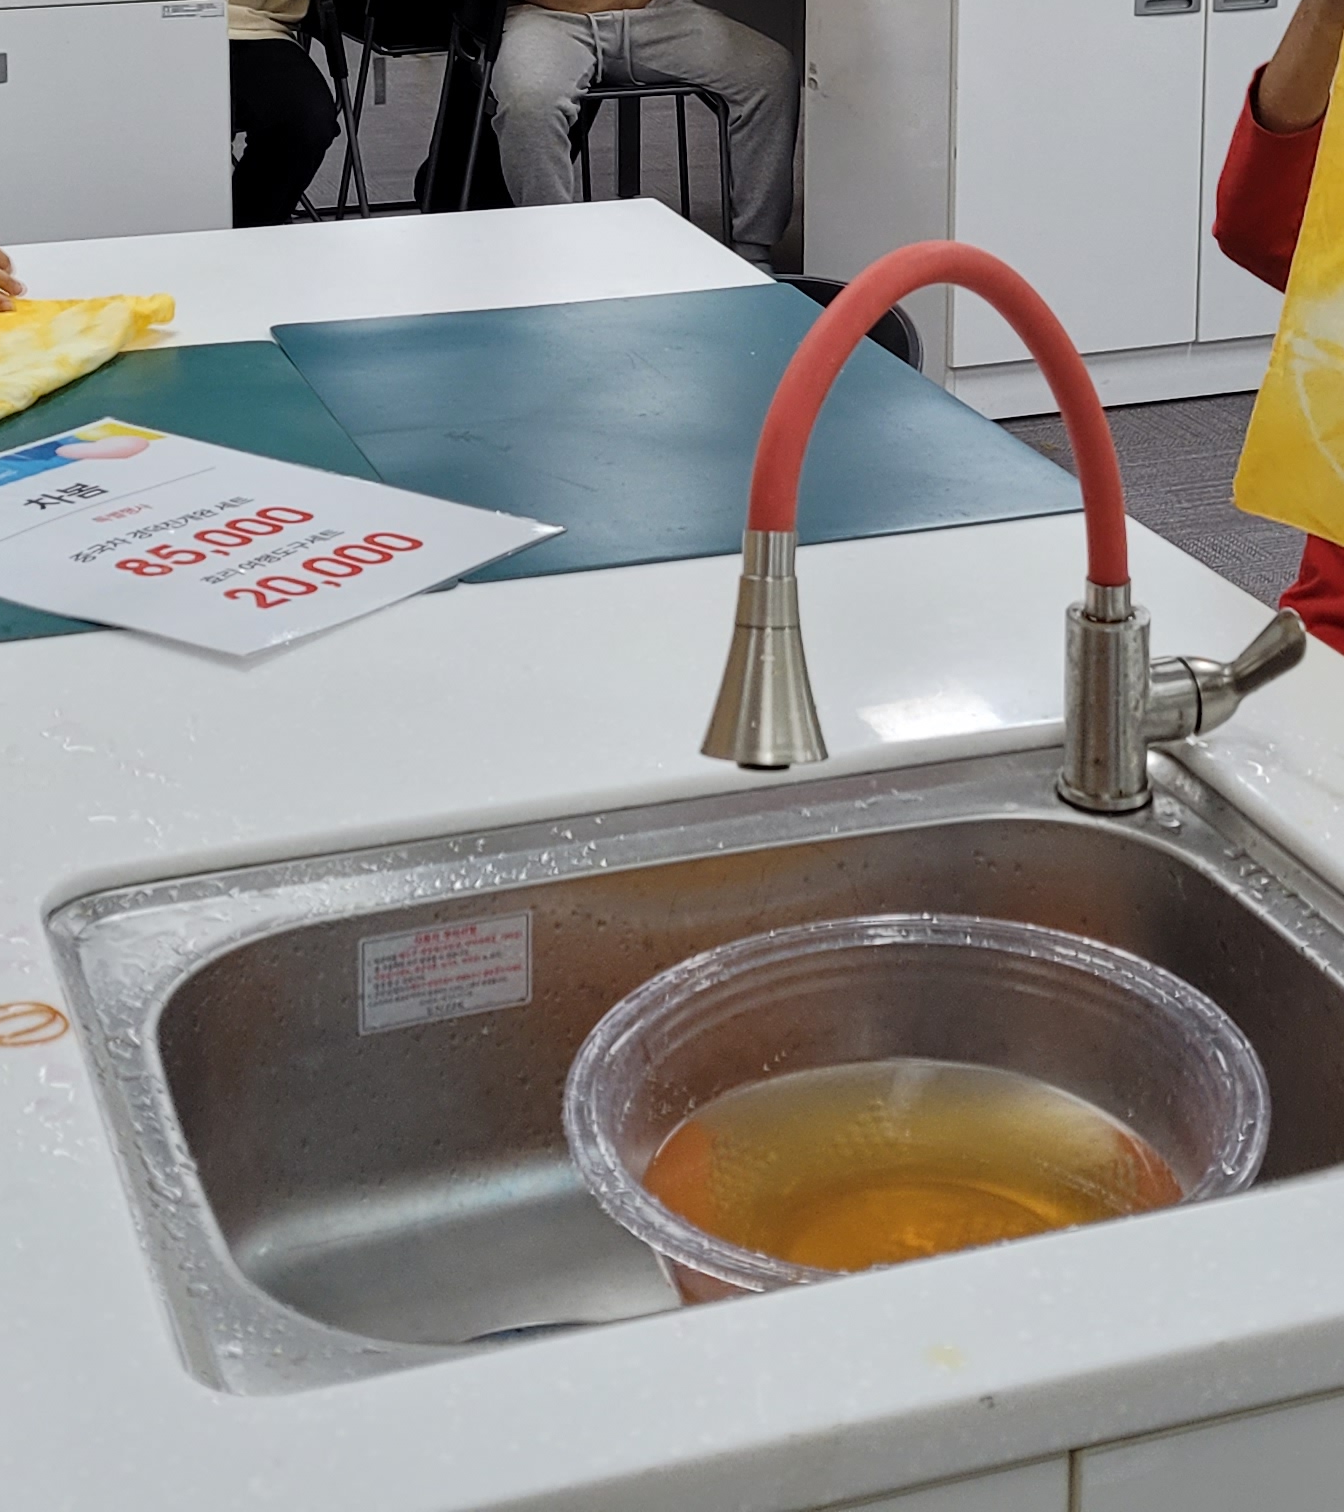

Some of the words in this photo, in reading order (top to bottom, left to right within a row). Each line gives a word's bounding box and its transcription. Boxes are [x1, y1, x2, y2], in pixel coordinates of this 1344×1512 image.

[23, 482, 109, 510] 차봄
[69, 537, 132, 564] 중국차
[215, 496, 254, 510] 세트
[115, 505, 314, 577] 85,000
[223, 532, 424, 609] 20,000
